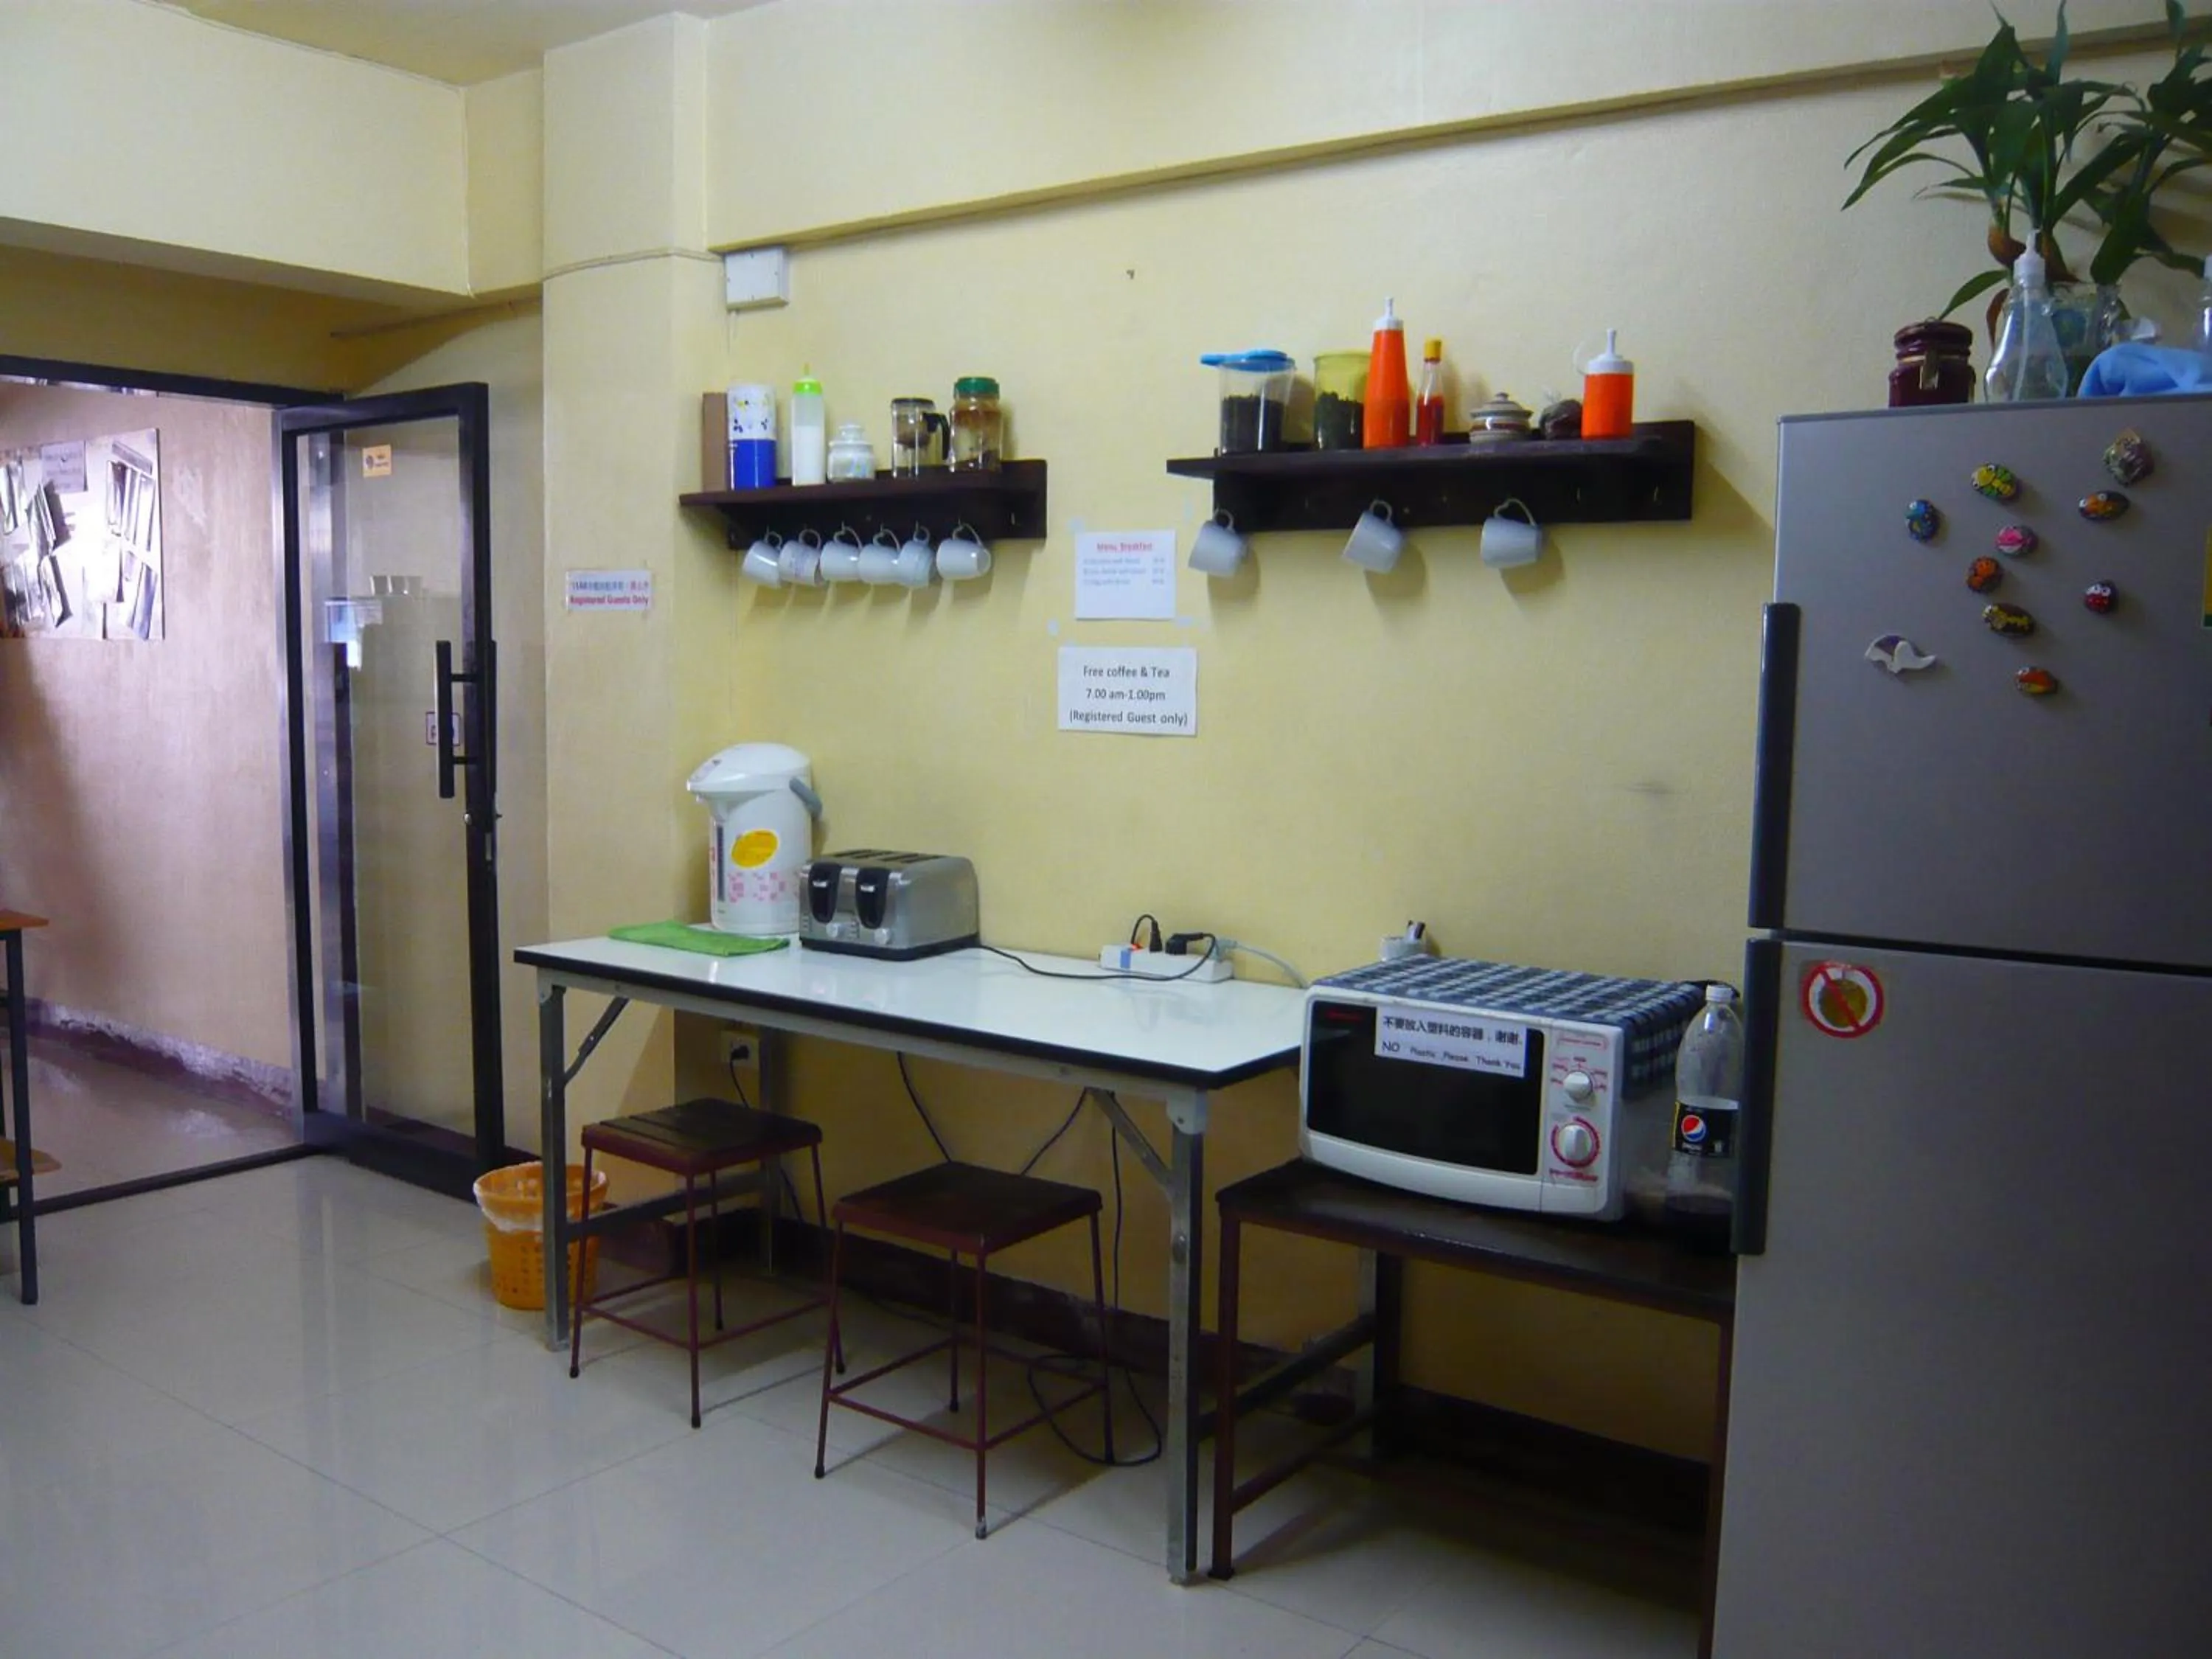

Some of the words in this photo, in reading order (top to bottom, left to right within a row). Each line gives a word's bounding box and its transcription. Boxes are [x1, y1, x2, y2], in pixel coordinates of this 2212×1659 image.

[632, 594, 649, 606] Only
[1083, 665, 1104, 678] Free
[1106, 665, 1138, 678] coffee
[1141, 667, 1148, 678] &
[1151, 667, 1170, 678] Tea
[1085, 688, 1107, 700] 7.00
[1069, 708, 1123, 723] (Registered
[1127, 712, 1156, 724] Guest
[1160, 712, 1189, 727] only)
[1382, 1040, 1400, 1053] NO
